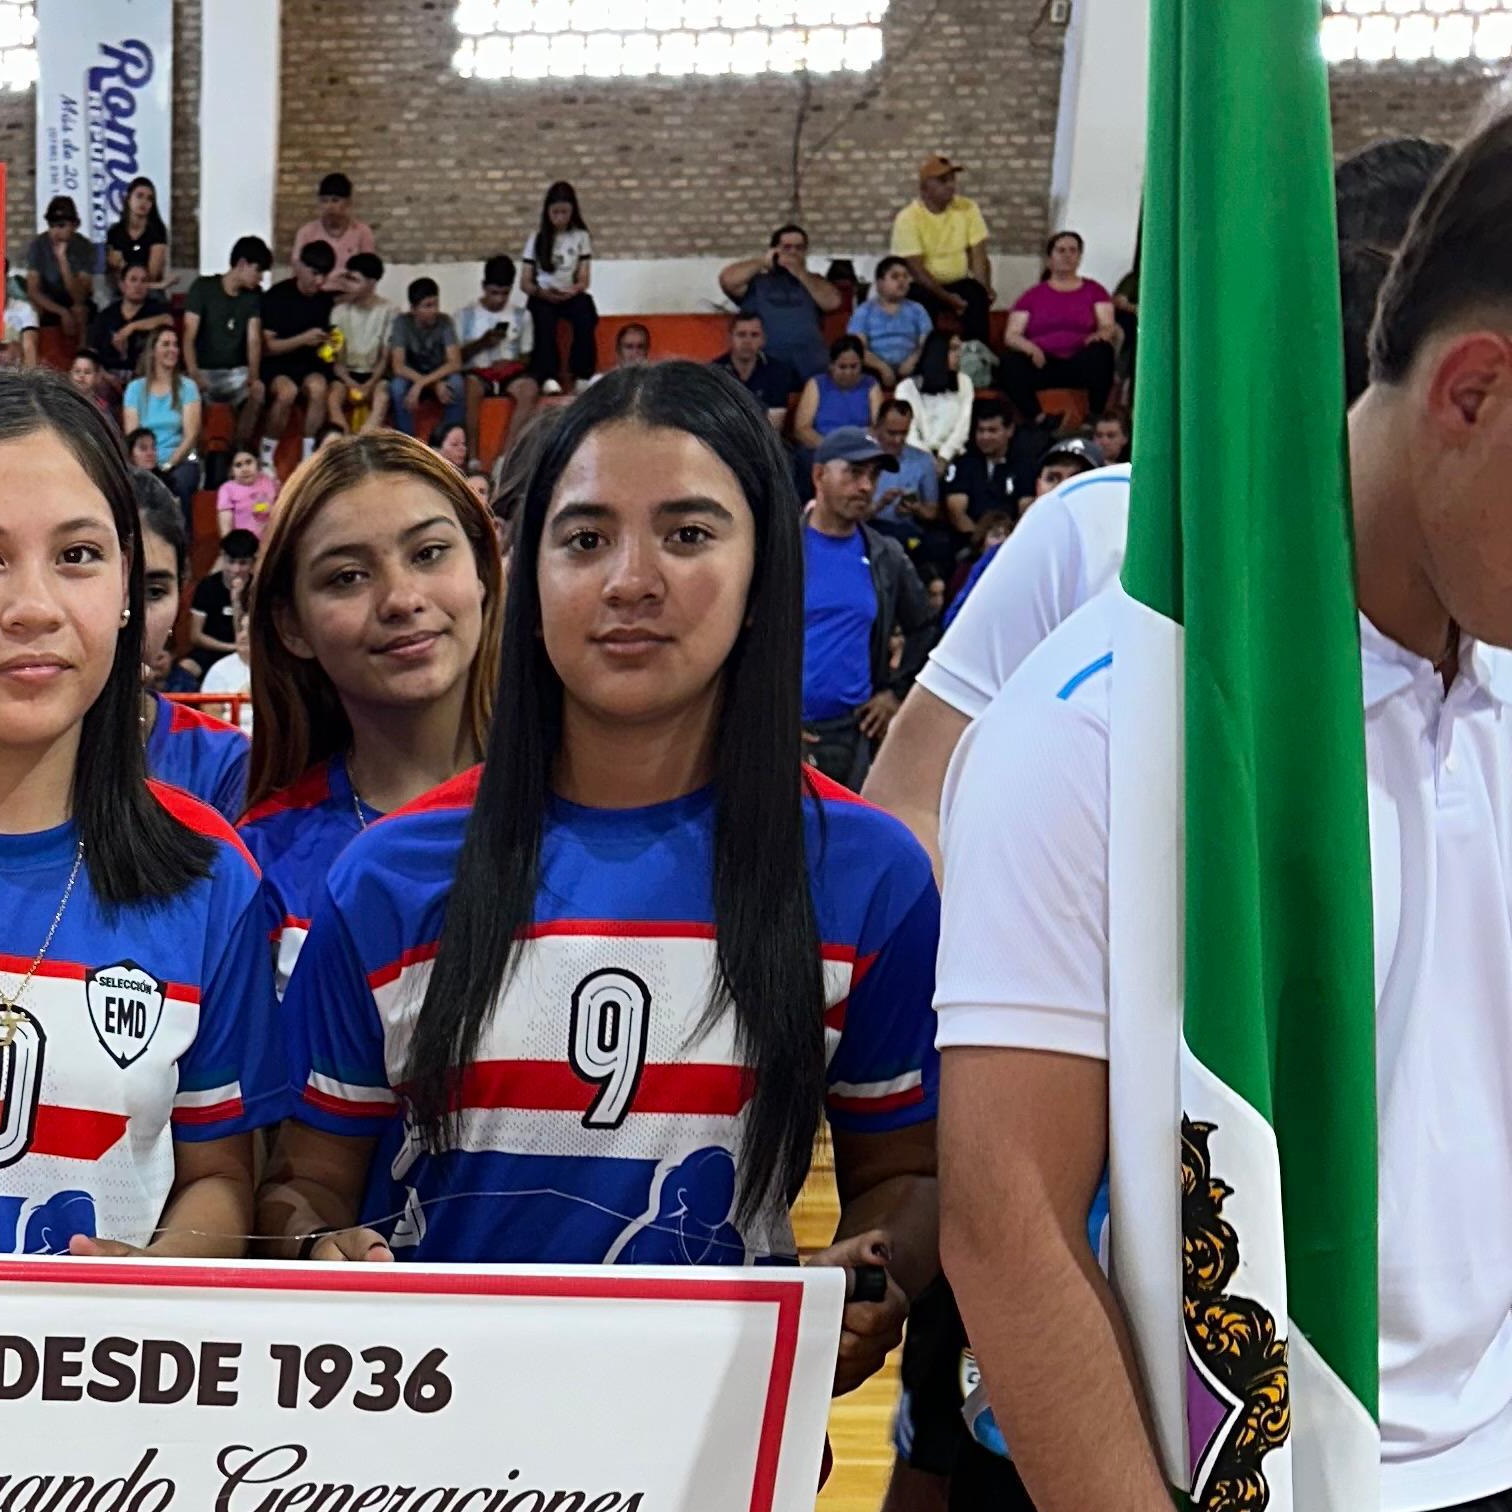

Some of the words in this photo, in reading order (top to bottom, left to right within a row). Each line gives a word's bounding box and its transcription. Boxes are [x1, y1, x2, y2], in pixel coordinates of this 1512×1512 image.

[89, 38, 155, 217] Rome
[99, 975, 153, 996] SELECCIÓN
[104, 995, 147, 1040] EMD
[567, 966, 653, 1130] 9
[269, 1341, 454, 1415] 1936
